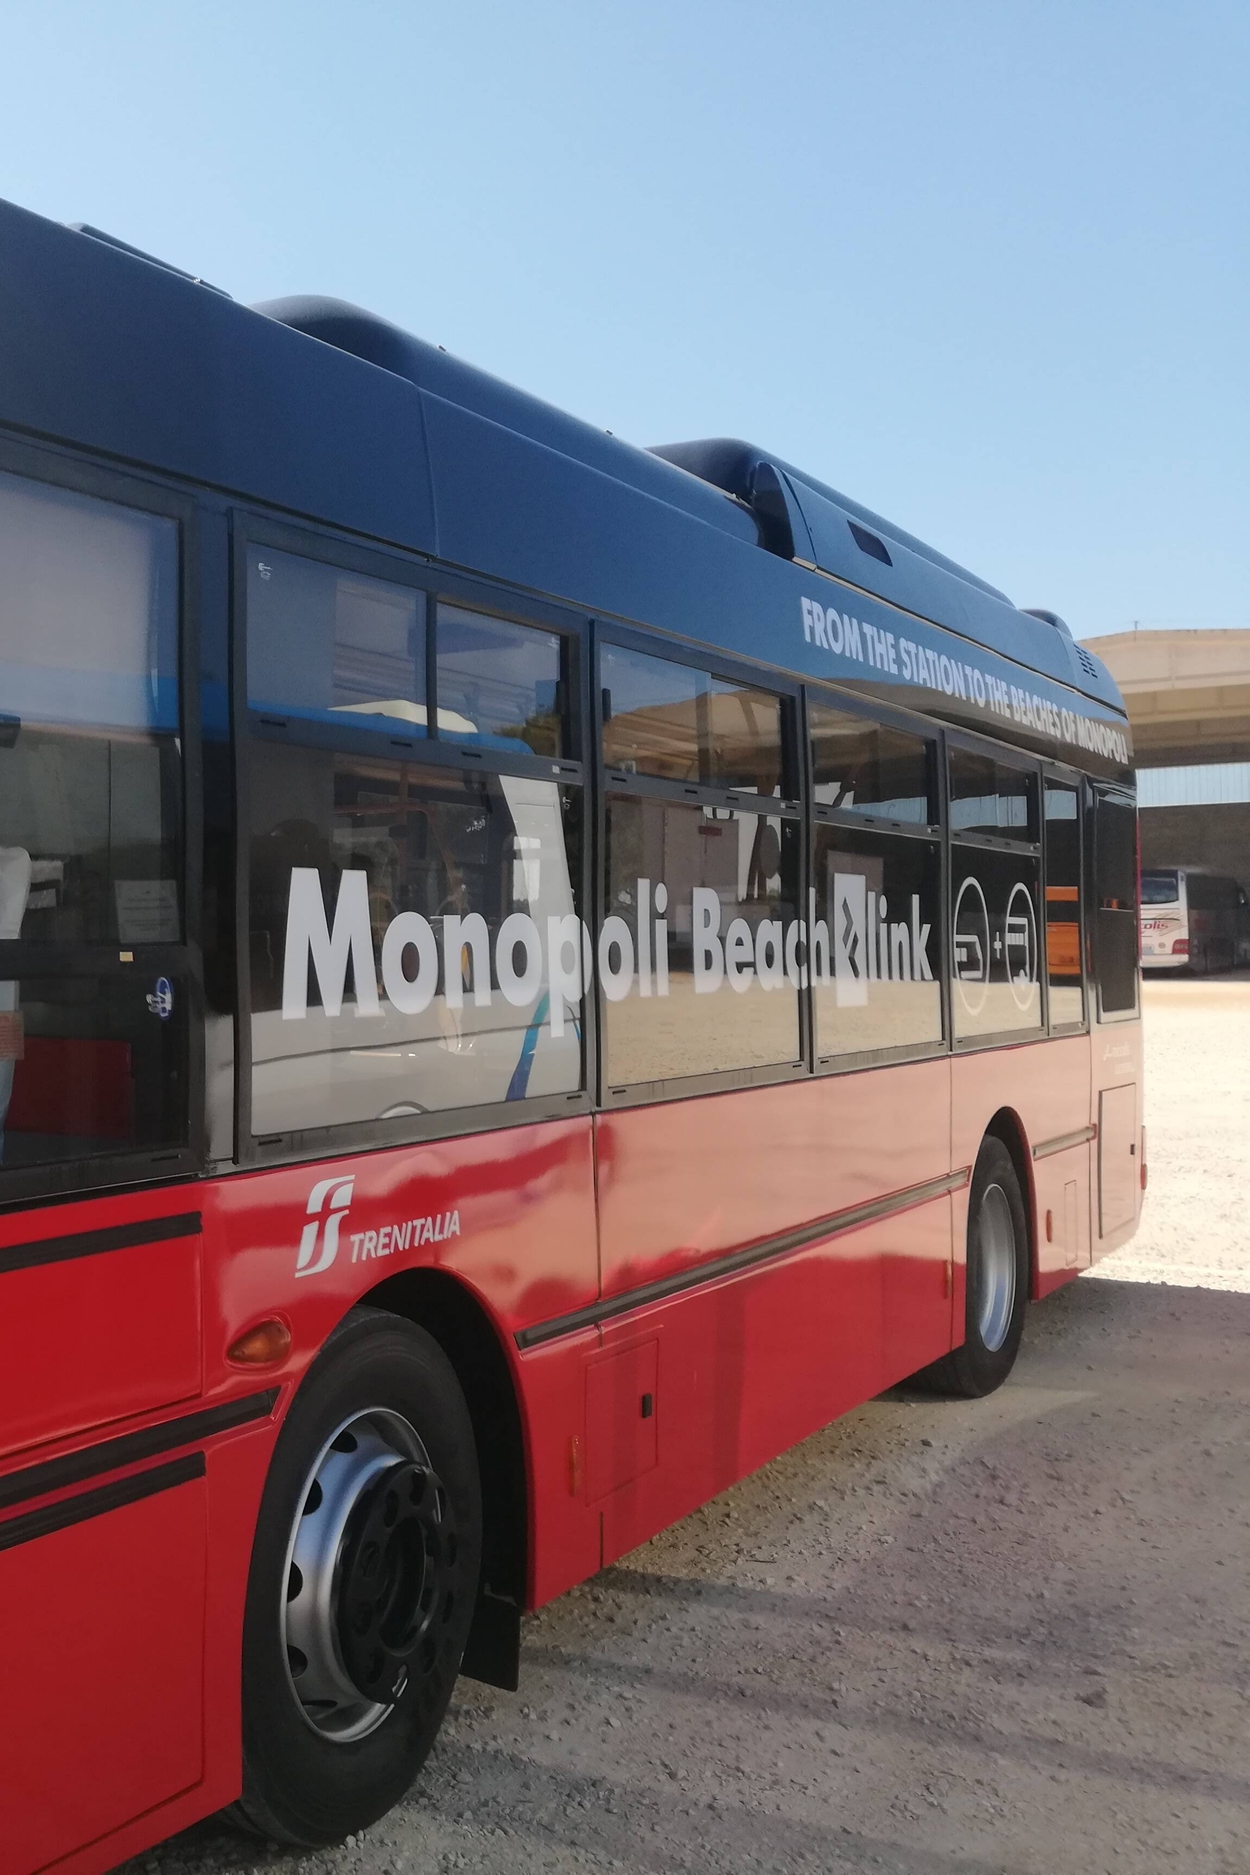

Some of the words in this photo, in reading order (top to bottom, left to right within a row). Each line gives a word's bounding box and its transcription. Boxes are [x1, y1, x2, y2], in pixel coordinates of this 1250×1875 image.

[801, 596, 864, 662] FROM
[862, 622, 899, 675] THE
[899, 637, 967, 700] STATION
[964, 666, 985, 708] TO
[985, 673, 1011, 719] THE
[1010, 685, 1062, 738] BEACHES
[1061, 707, 1076, 744] OF
[1075, 714, 1129, 765] MONOPOLI
[282, 867, 670, 1038] Monopoli
[693, 886, 831, 994] Beach
[867, 890, 934, 982] link
[350, 1210, 461, 1263] TRENITALIA
